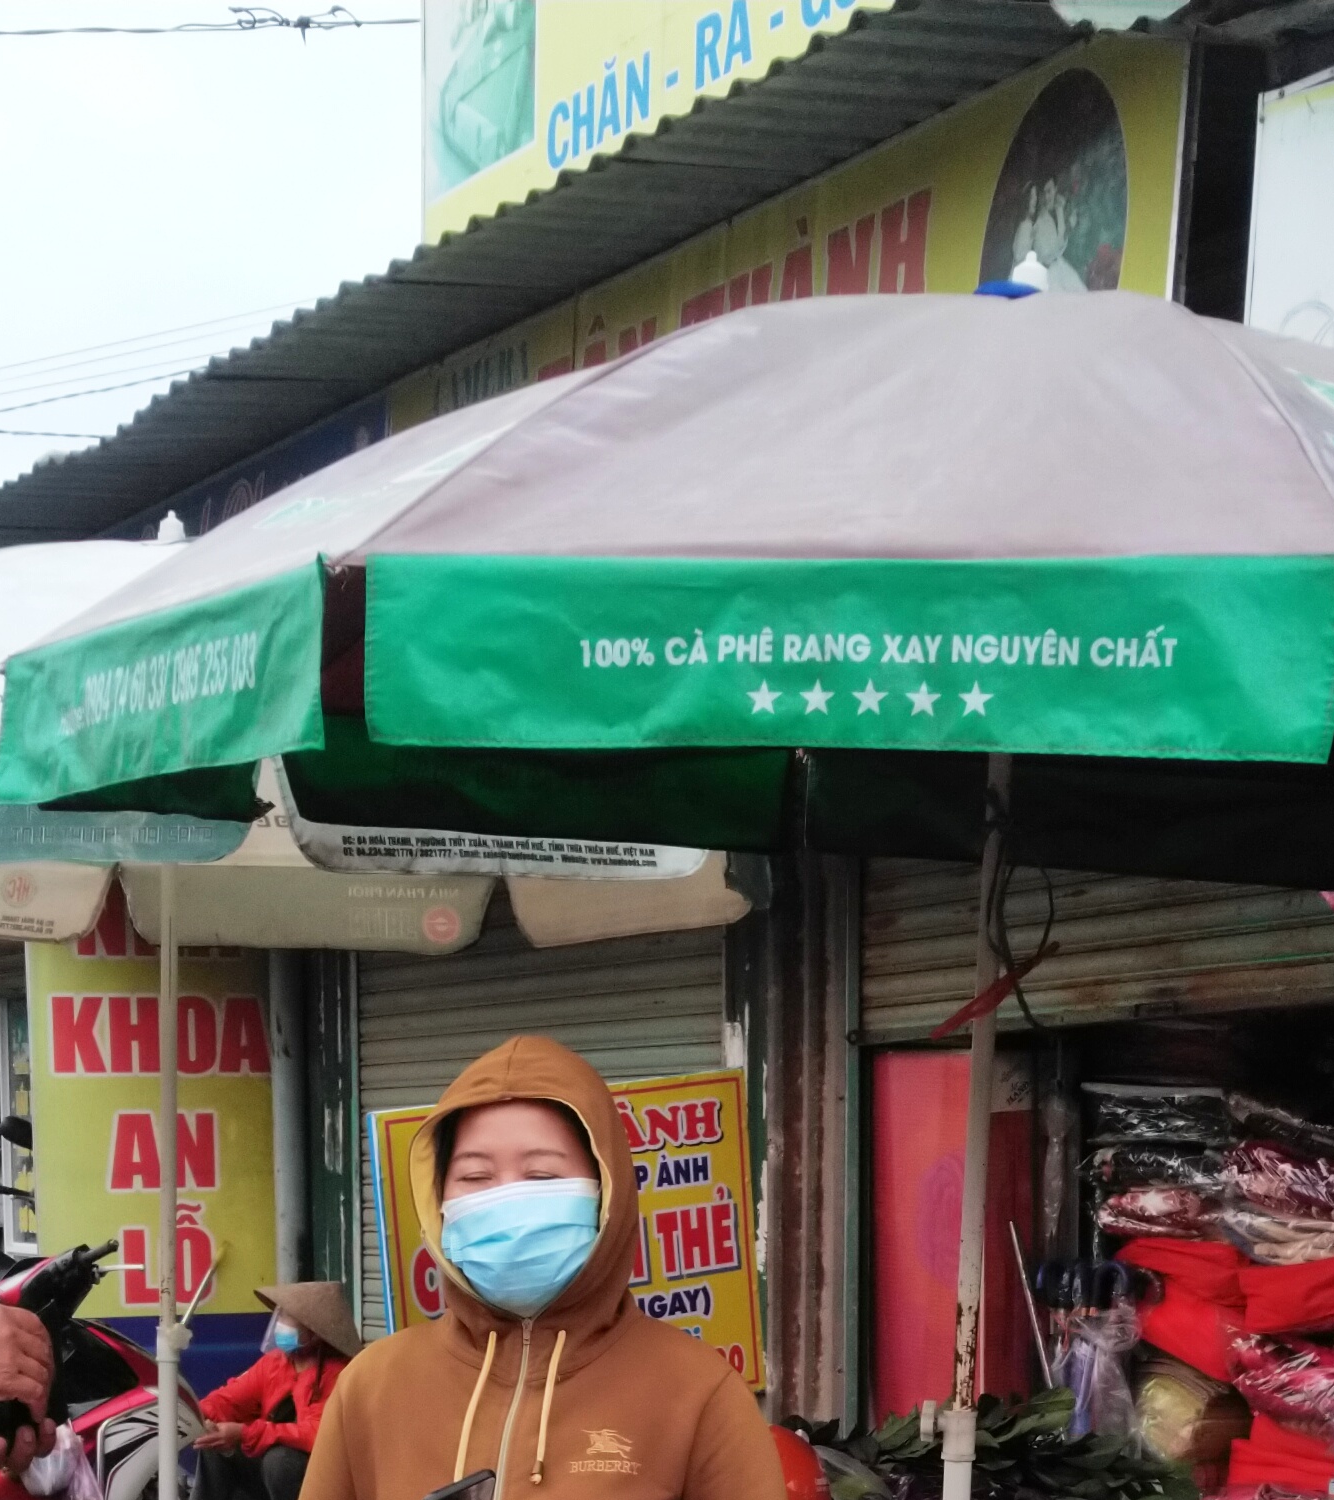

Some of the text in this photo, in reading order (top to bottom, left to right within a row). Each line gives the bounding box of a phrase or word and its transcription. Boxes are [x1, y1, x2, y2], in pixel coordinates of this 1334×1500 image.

[547, 51, 651, 169] CHĂN
[580, 625, 1178, 668] 100% CÀ PHÊ RANG XAY NGUYÊN CHẤT
[52, 995, 272, 1074] KHOA
[110, 1112, 216, 1190] AN
[656, 1155, 709, 1188] ẢNH
[122, 1203, 214, 1305] LỖ
[654, 1187, 738, 1276] THẺ
[569, 1459, 642, 1475] BURBERRY
